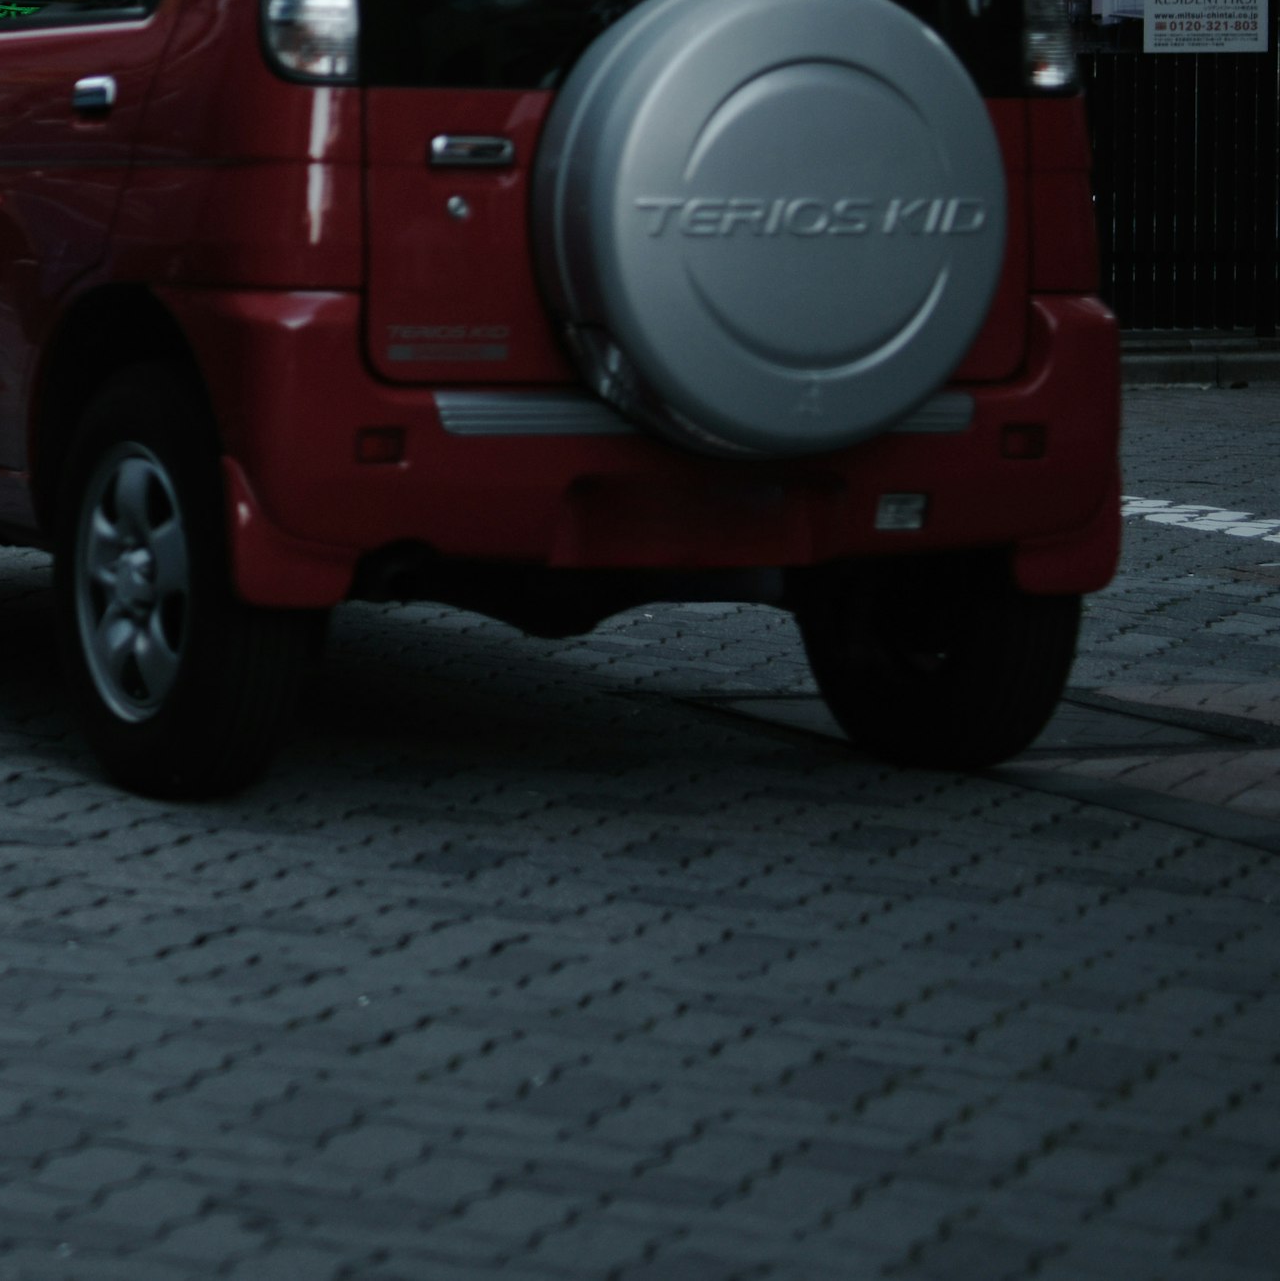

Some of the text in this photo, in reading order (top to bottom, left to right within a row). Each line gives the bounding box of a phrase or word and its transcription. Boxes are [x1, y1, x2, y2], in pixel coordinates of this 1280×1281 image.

[1154, 11, 1259, 20] www.mitsui-chintai.co.jp
[1169, 21, 1258, 31] 0120-321-803
[634, 195, 987, 238] TERIOS KID
